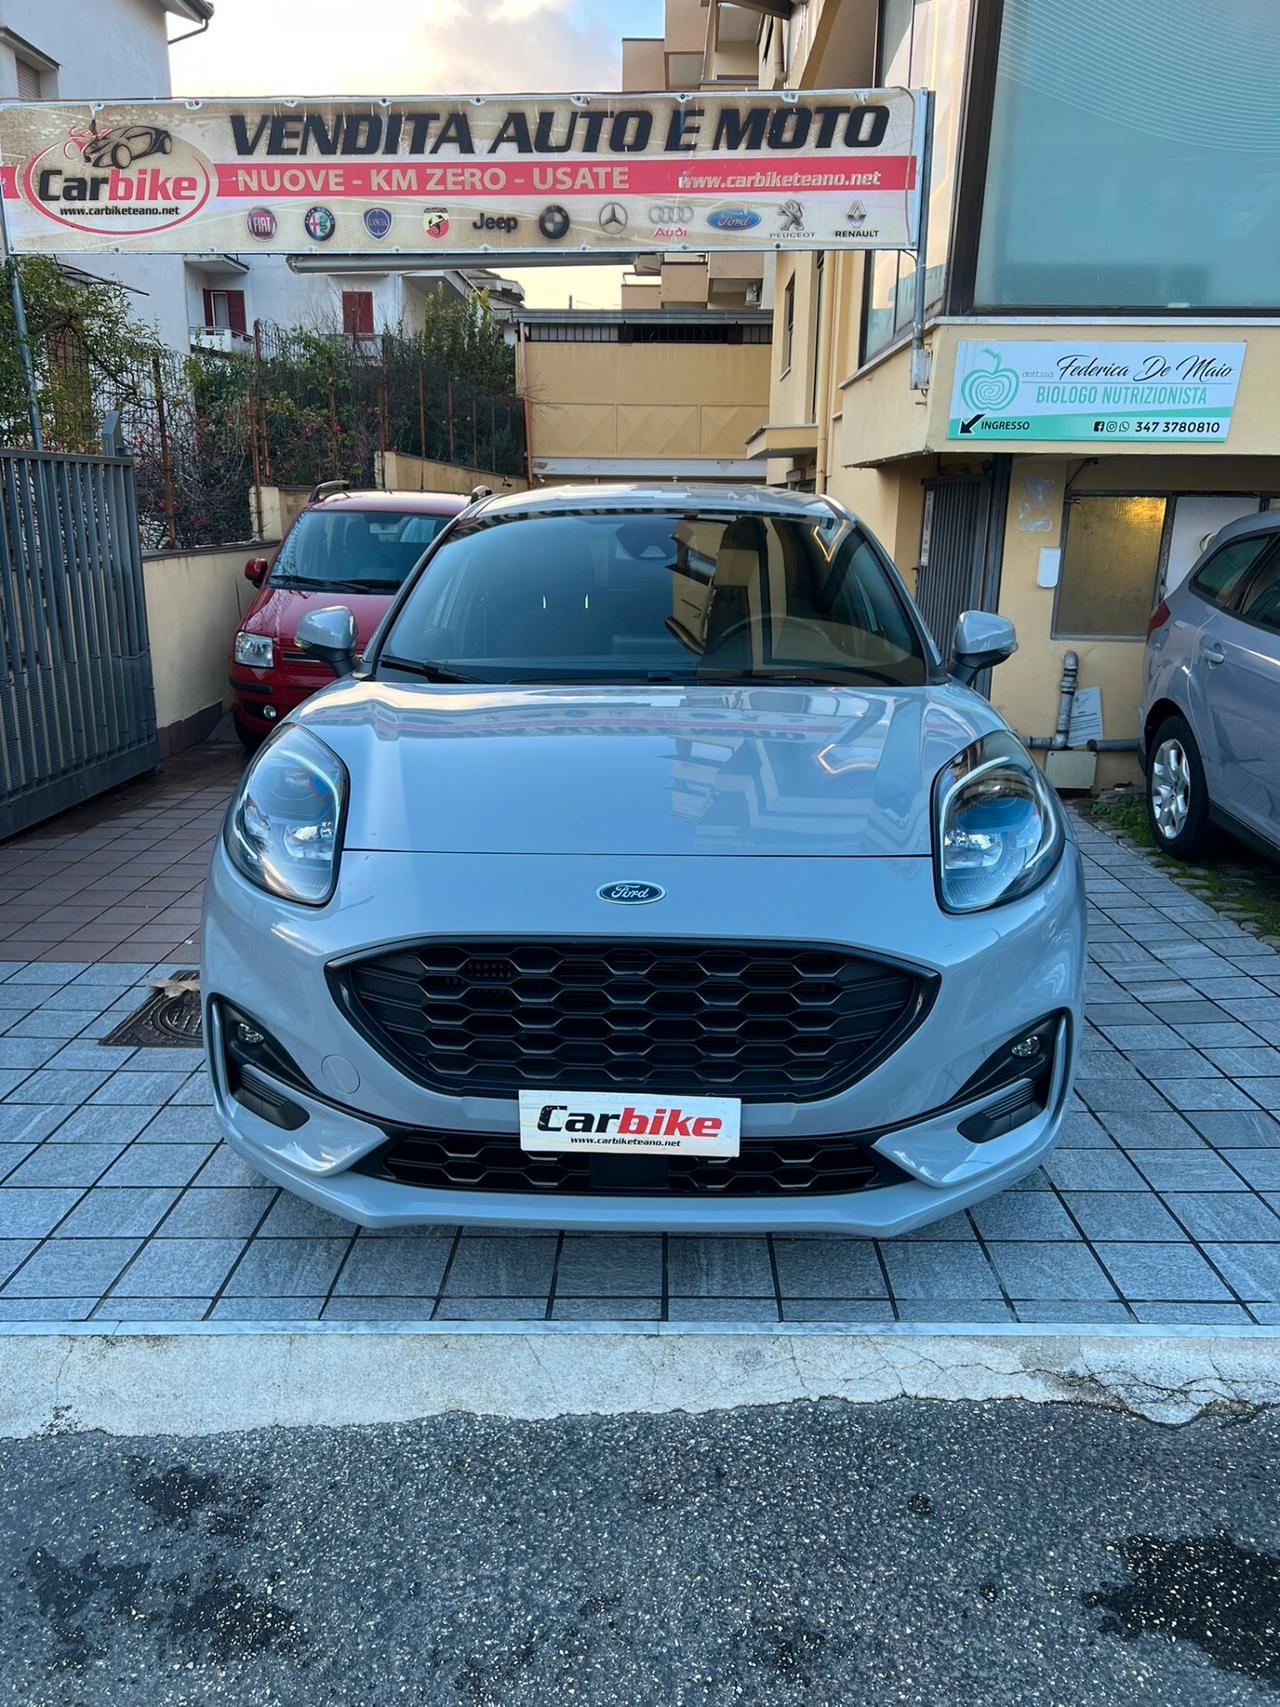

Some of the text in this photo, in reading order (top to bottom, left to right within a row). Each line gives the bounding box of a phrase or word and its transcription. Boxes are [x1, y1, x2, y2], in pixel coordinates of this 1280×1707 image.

[229, 105, 890, 156] VENDITA AUTO E MOTO
[38, 168, 197, 202] Carbike
[237, 168, 345, 192] NUOVE
[370, 168, 418, 191] KM
[426, 167, 507, 191] ZERO
[532, 166, 630, 190] USATE
[678, 170, 881, 189] www.carbiketeano.net
[59, 205, 181, 217] www.carbiketeano.net
[717, 210, 750, 227] Ford
[253, 216, 272, 234] FIAT
[472, 212, 518, 233] Jeep
[654, 227, 688, 238] Audi
[834, 230, 880, 238] RENAULT
[1056, 354, 1130, 381] Federica
[1132, 355, 1172, 382] De
[1175, 354, 1233, 382] Maio
[1036, 386, 1207, 405] BIOLOGO NUTRIZIONISTA
[980, 420, 1031, 431] INGRESSO
[1135, 421, 1221, 434] 347 3780810
[611, 884, 650, 898] Ford
[536, 1104, 723, 1138] Carbike
[570, 1136, 682, 1148] www.carbiketeano.net
